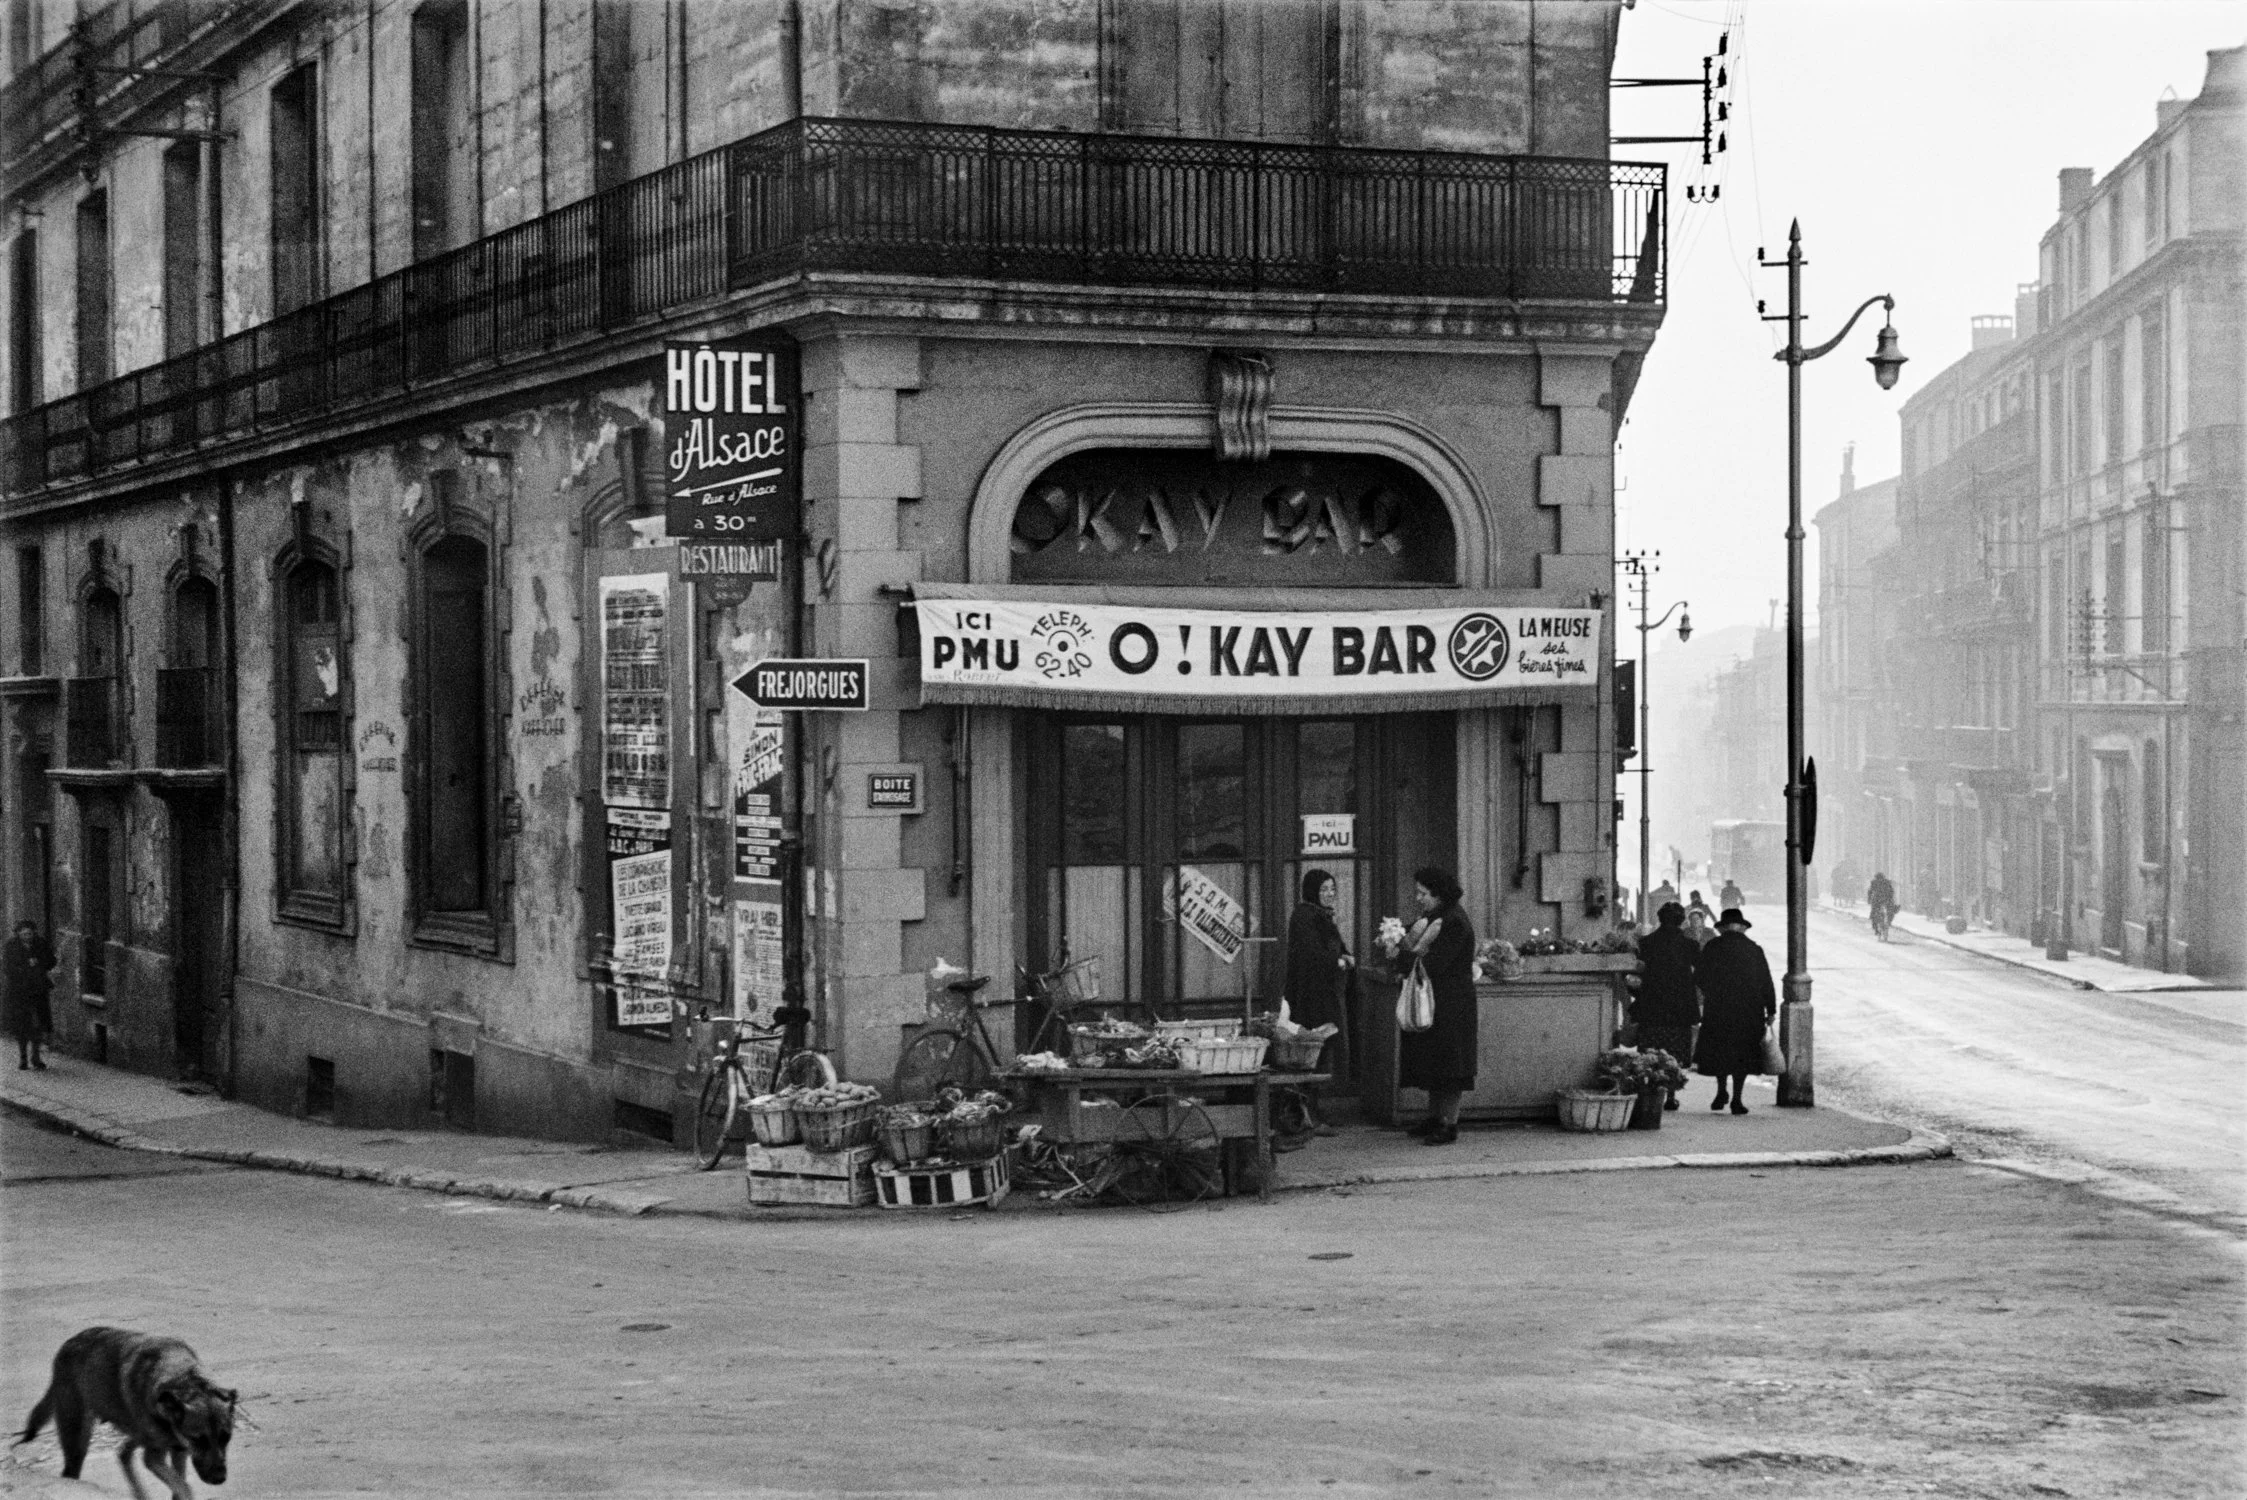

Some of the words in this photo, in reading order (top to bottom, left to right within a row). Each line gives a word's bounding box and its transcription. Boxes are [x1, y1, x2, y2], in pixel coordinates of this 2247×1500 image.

[667, 345, 787, 414] HÔTEL
[669, 418, 785, 483] d'Alsace
[702, 493, 725, 506] Rue
[680, 546, 776, 574] RESTAURANT
[956, 612, 991, 631] ICI
[1519, 617, 1538, 638] LA
[1541, 617, 1592, 638] MEUSE
[933, 636, 1020, 672] PMU
[1332, 624, 1437, 676] BAR
[1540, 641, 1570, 655] ses
[1035, 651, 1093, 679] 62-40
[1554, 656, 1588, 679] fines
[758, 670, 860, 699] FREJORGUES
[874, 778, 911, 790] BOITE
[1308, 831, 1350, 847] PMU
